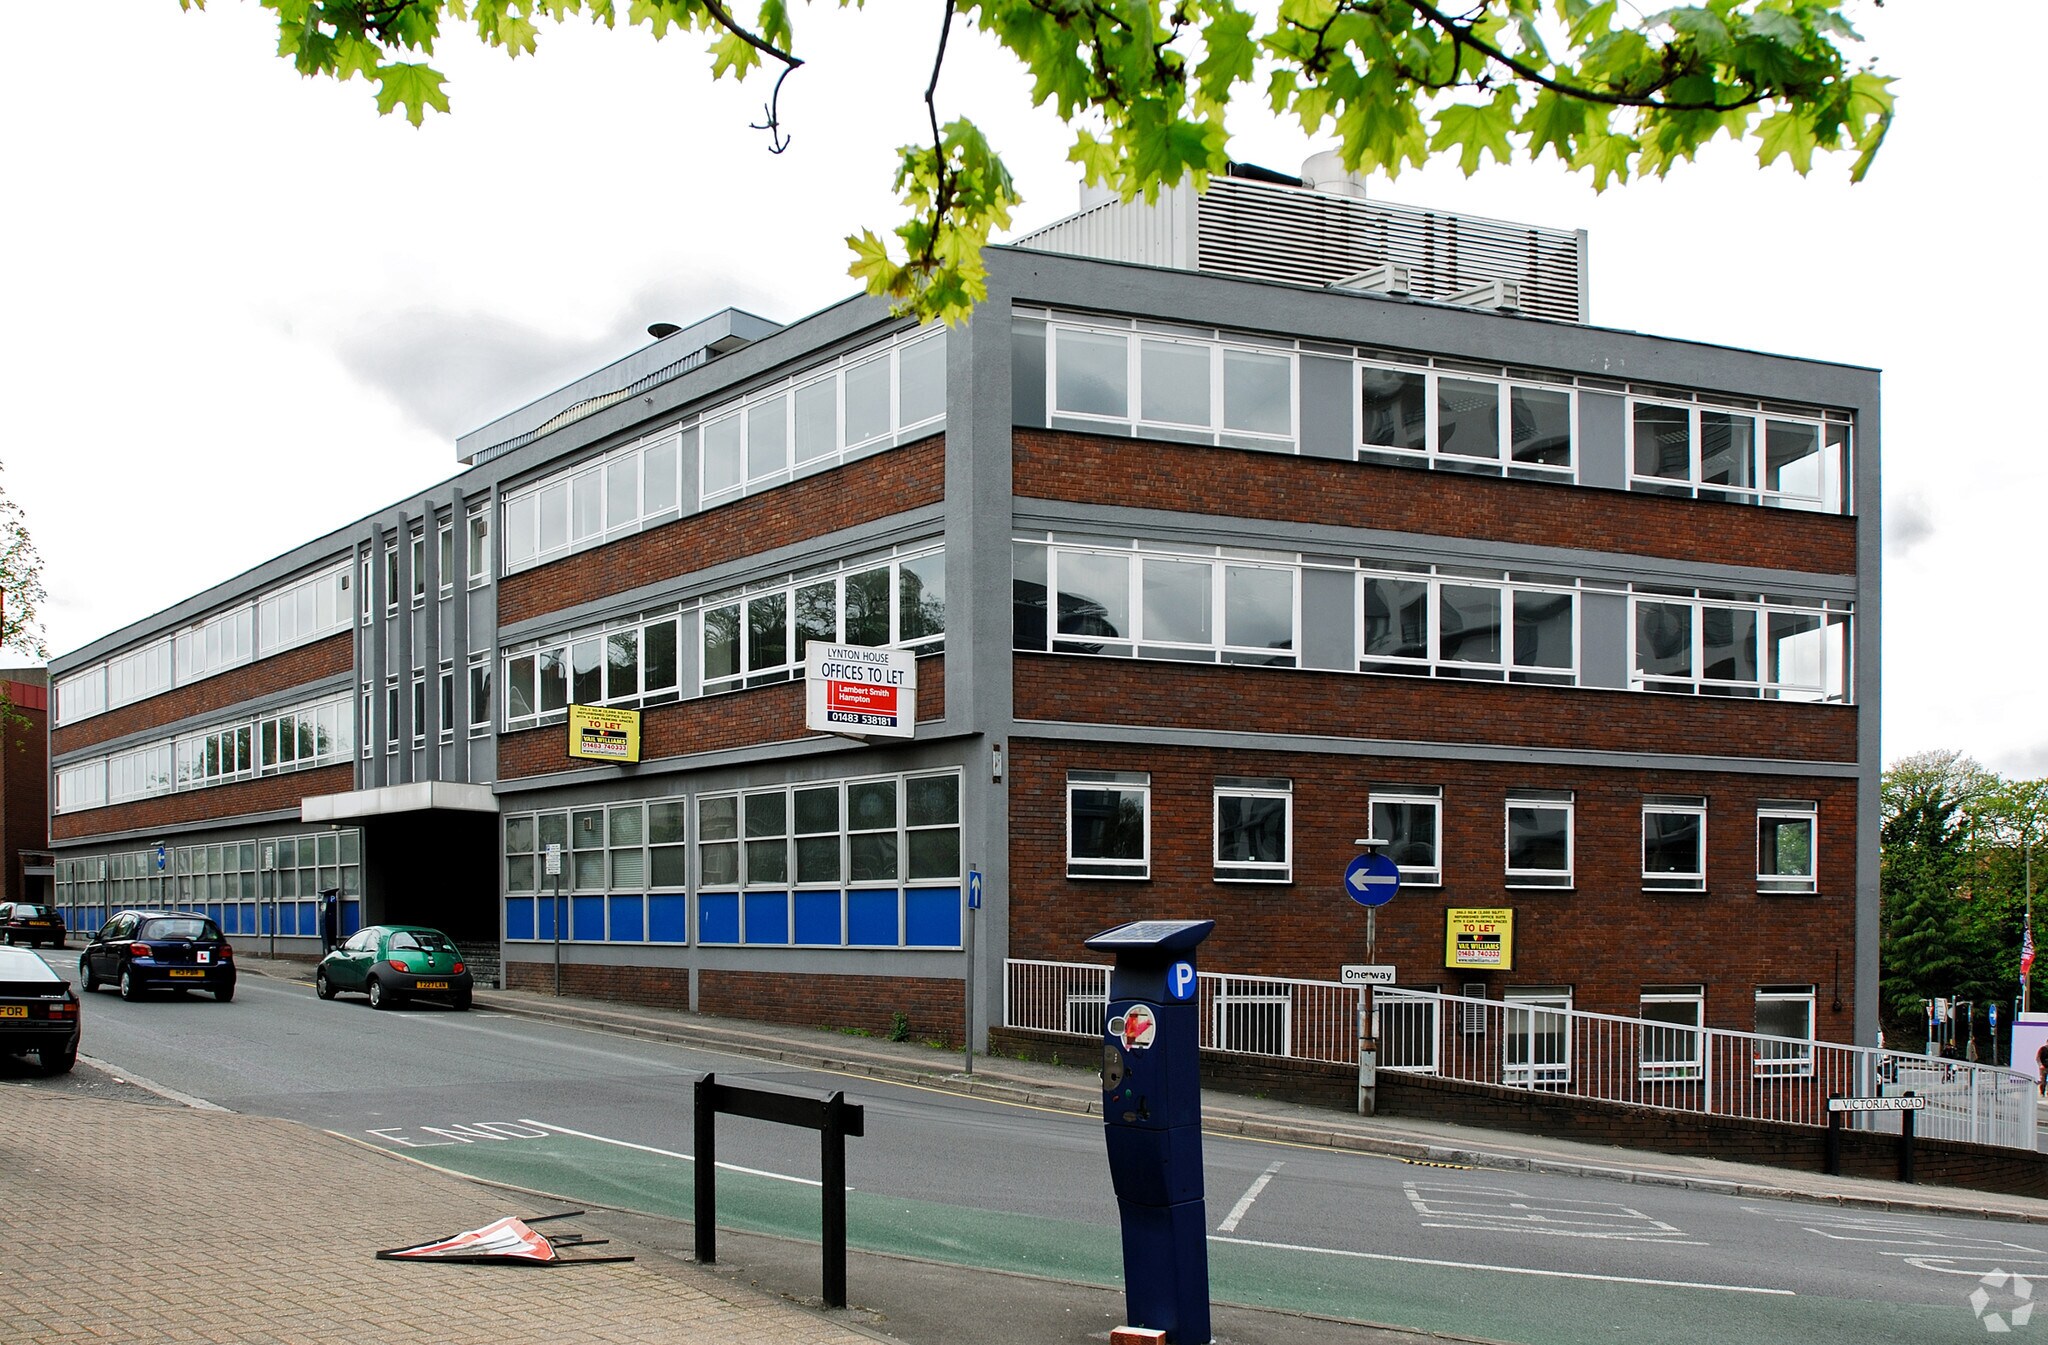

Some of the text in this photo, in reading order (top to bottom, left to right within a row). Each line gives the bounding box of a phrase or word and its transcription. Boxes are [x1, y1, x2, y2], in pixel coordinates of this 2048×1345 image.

[828, 648, 889, 663] LYNTON HOUSE
[822, 662, 904, 684] OFFICES TO LET
[839, 685, 889, 697] Lambert Smith
[839, 693, 870, 703] Hampton
[832, 712, 891, 725] 01483 538181
[1176, 963, 1193, 997] P
[1345, 970, 1392, 981] One way
[1843, 1099, 1922, 1109] VICTORIA ROAD
[366, 1122, 549, 1147] END
